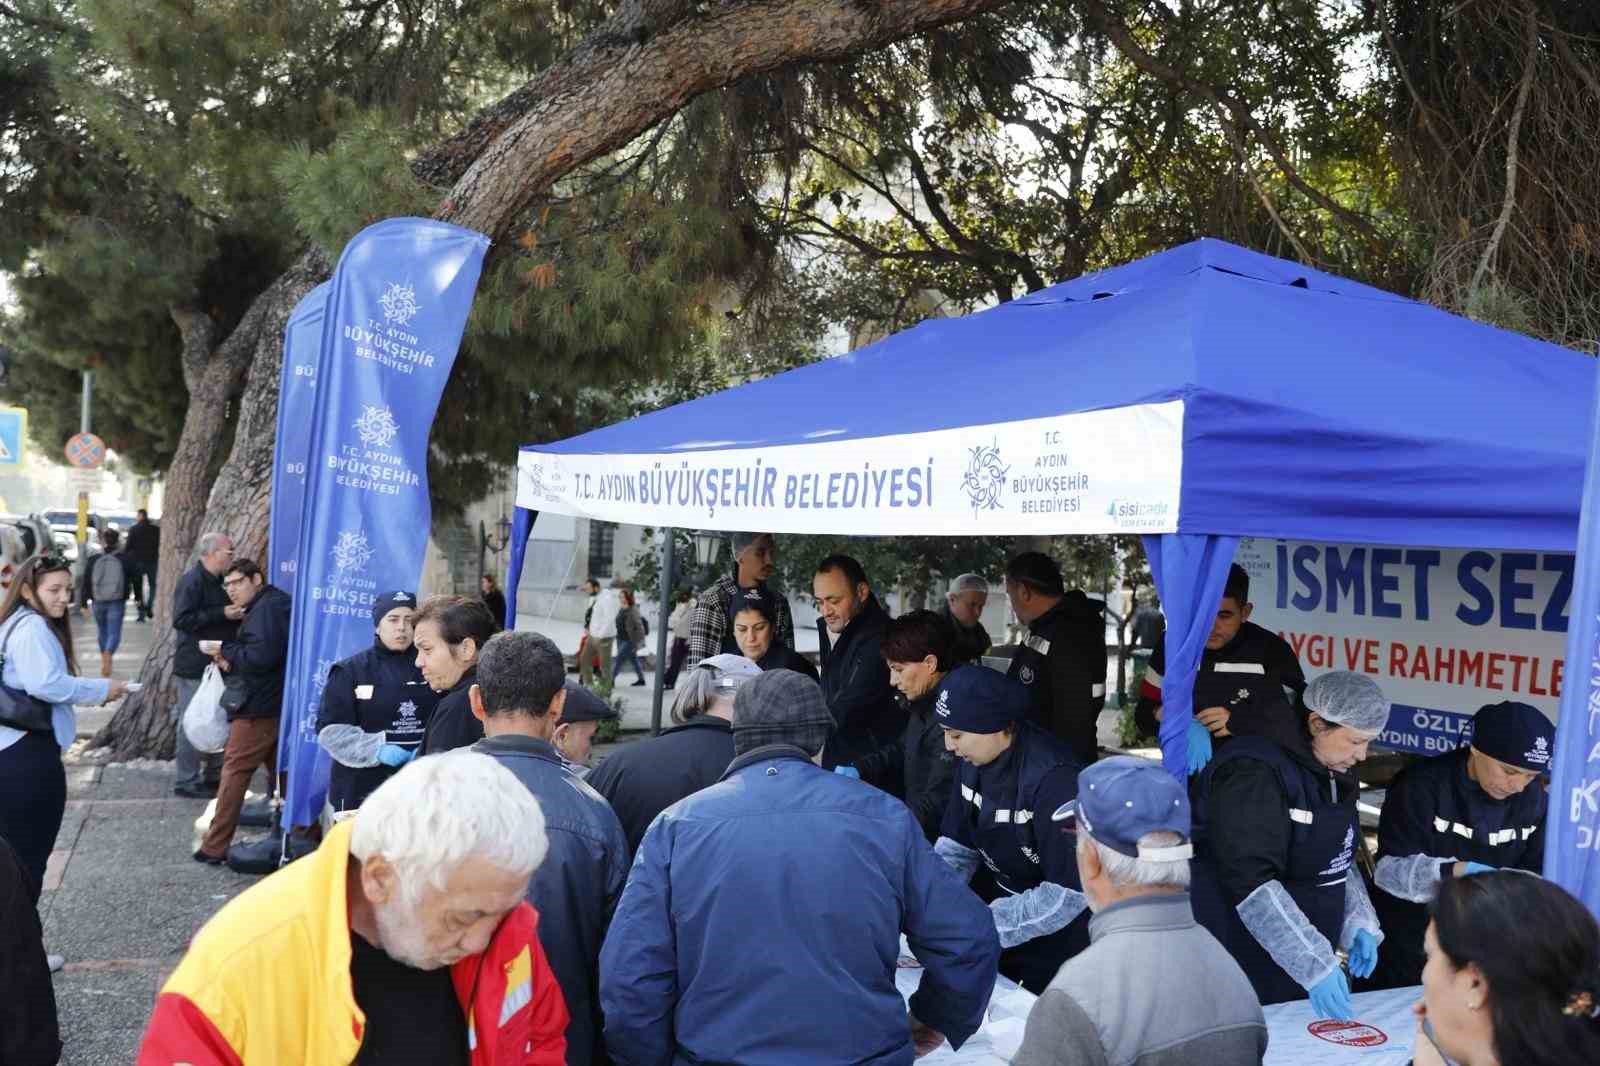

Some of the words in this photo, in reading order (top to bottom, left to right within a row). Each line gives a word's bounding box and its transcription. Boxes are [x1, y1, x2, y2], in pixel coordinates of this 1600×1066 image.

[1044, 431, 1061, 446] T.C.
[364, 450, 402, 466] AYDIN
[1035, 453, 1067, 468] AYDIN
[574, 473, 594, 499] T.C.
[597, 473, 636, 502] AYDIN
[639, 458, 778, 518] BÜYÜKŞEHİR
[784, 457, 934, 509] BELEDİYESİ
[1012, 473, 1088, 495] BÜYÜKŞEHİR
[1021, 498, 1081, 514] BELEDİYESİ
[1276, 539, 1440, 620] İSMET
[1456, 550, 1577, 633] SEZ
[1344, 638, 1380, 674] VE
